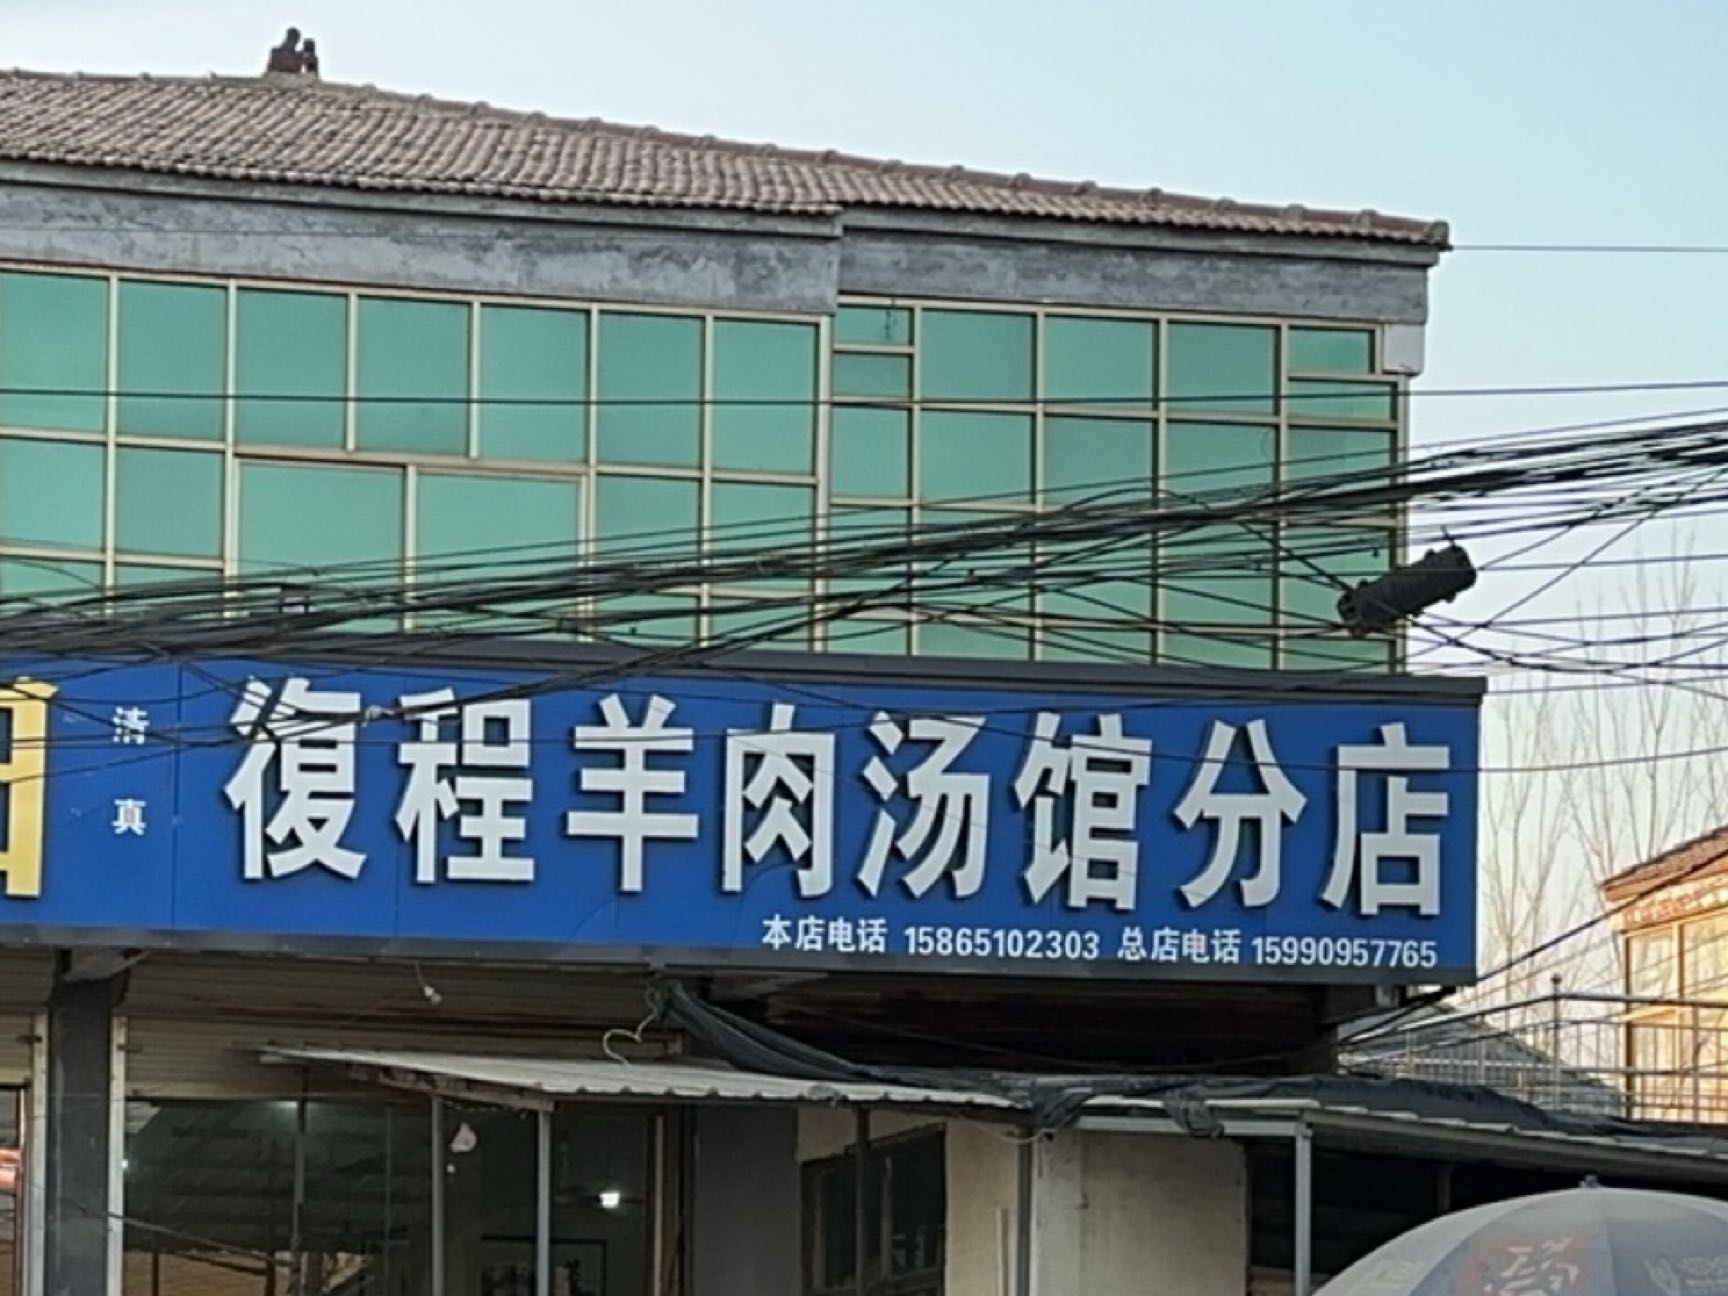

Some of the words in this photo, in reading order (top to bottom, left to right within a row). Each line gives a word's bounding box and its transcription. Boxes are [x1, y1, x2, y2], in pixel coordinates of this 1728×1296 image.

[761, 914, 889, 953] 本店电话
[903, 926, 1101, 960] 15865102303
[1117, 926, 1241, 964] 总店电话
[1250, 936, 1438, 968] 15990957765
